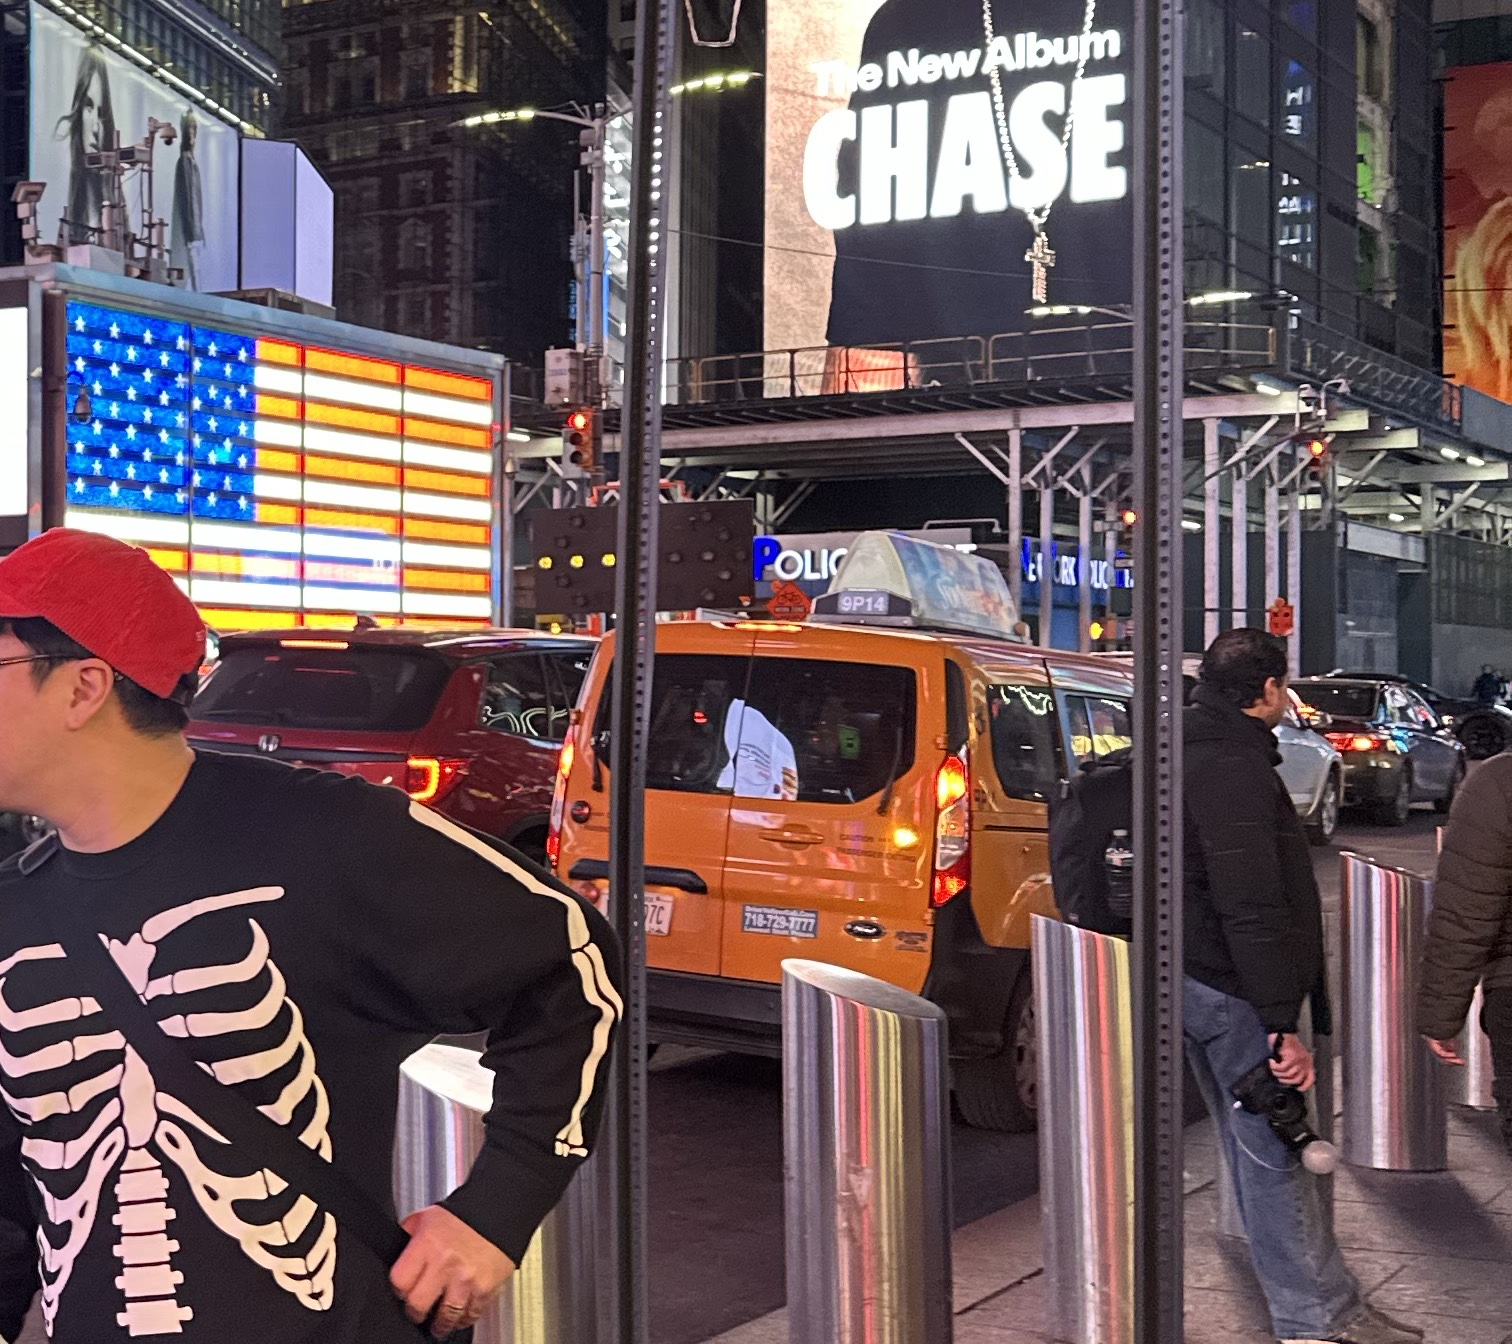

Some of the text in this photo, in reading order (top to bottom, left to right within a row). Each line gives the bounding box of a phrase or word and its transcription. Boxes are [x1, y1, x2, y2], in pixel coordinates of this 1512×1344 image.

[810, 29, 1121, 97] The New Album
[802, 73, 1127, 230] CHASE
[753, 535, 849, 581] POLIC
[840, 594, 886, 613] 9P14
